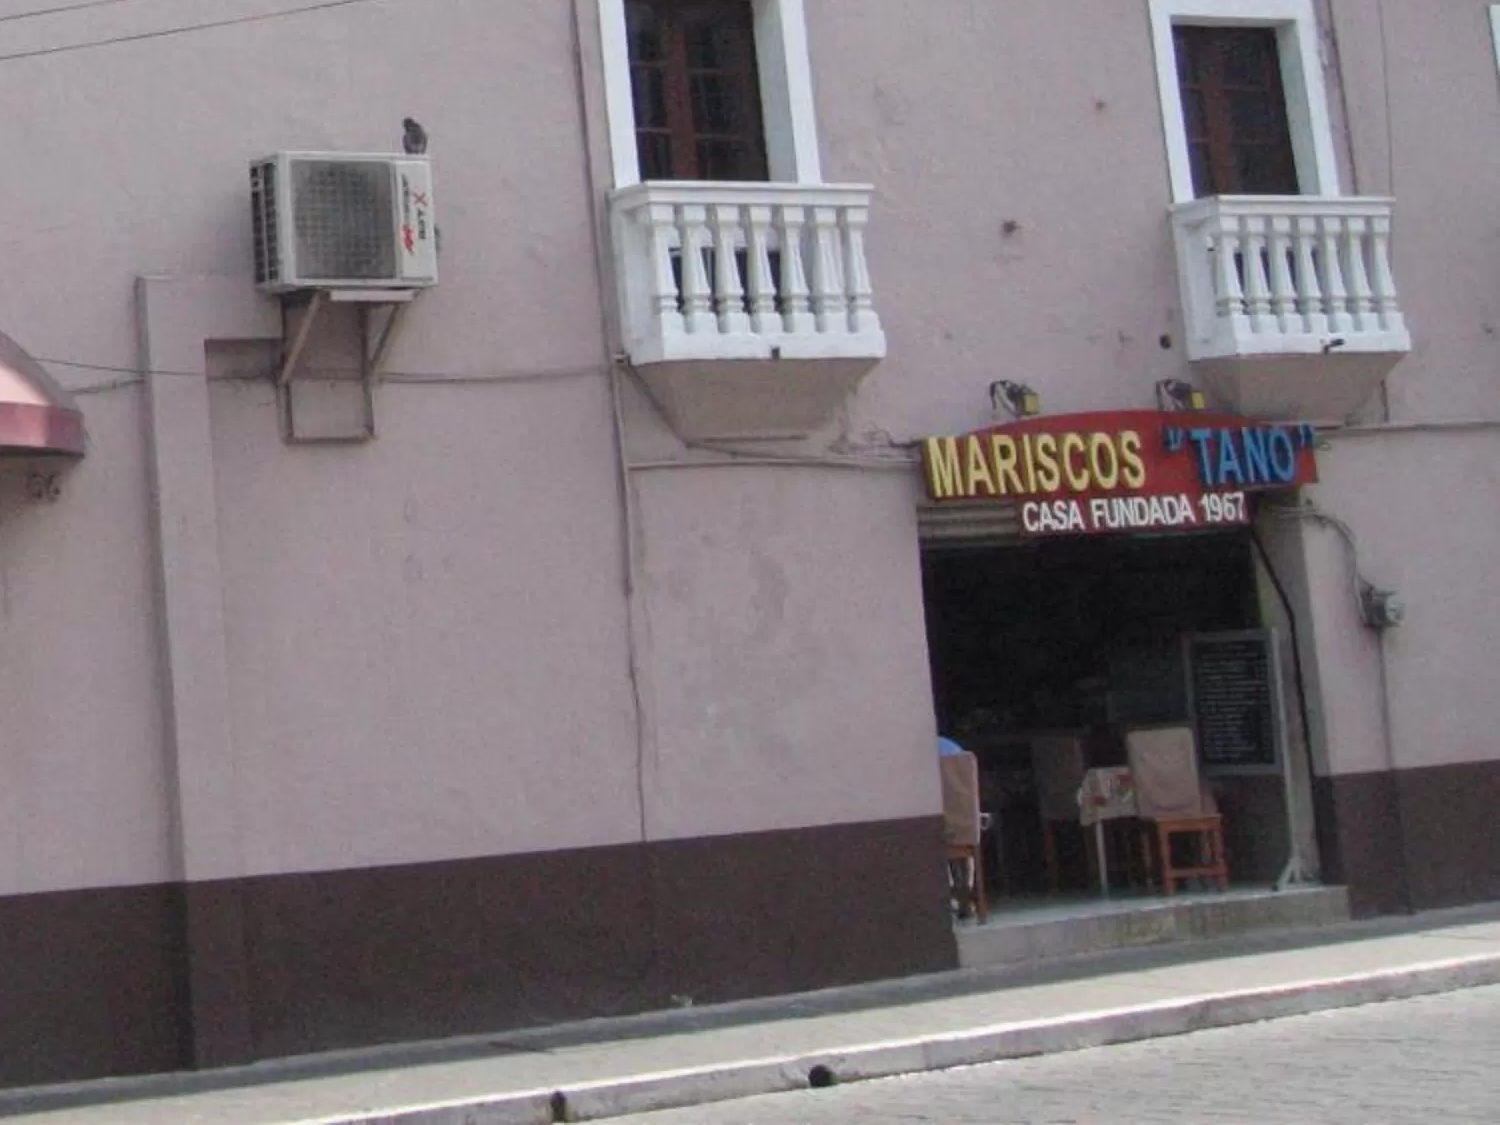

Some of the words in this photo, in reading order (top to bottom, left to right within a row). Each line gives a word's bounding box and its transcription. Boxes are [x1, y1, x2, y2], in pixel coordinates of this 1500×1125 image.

[926, 429, 1146, 498] MARISCOS
[1022, 499, 1085, 533] CASA
[1090, 494, 1197, 530] FUNDADA
[1200, 490, 1246, 523] 1967
